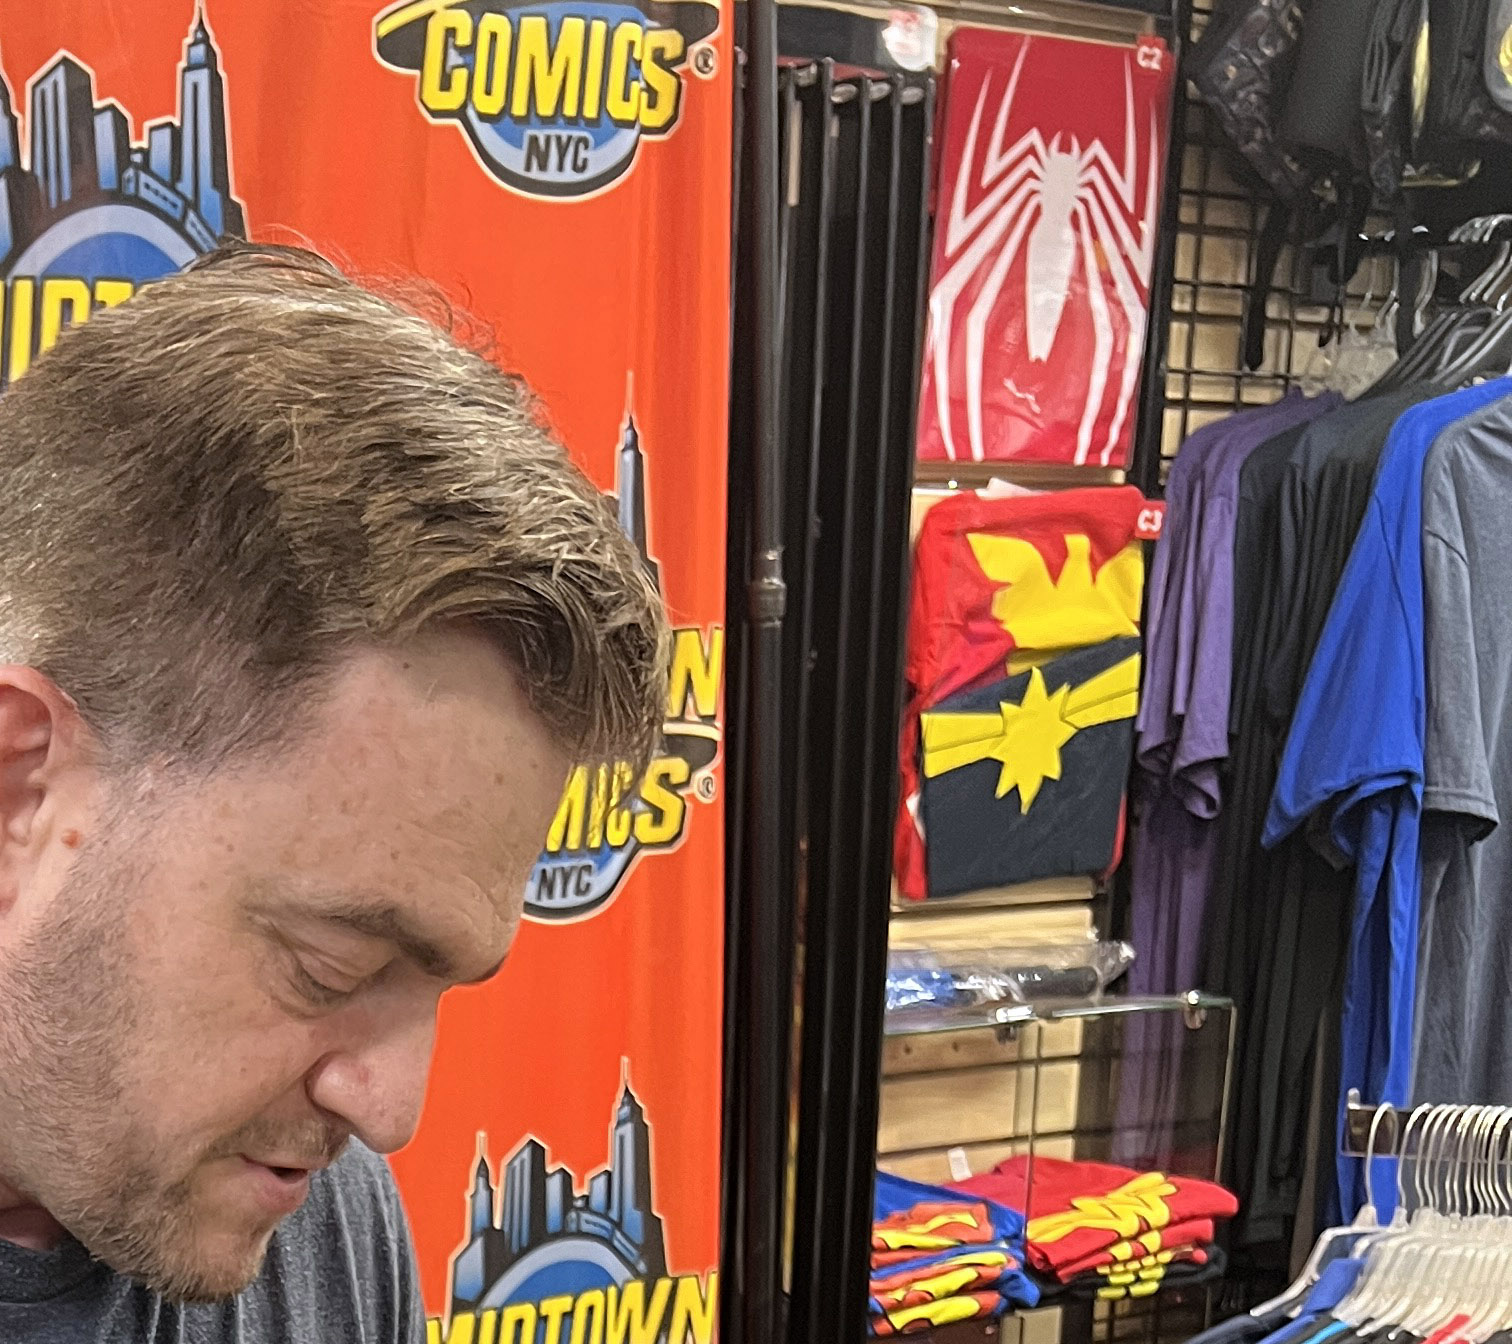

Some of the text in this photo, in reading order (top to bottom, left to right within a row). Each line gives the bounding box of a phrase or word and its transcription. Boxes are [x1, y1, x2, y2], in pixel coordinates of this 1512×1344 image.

[420, 9, 685, 128] COMICS
[1137, 45, 1163, 70] C2
[524, 133, 589, 174] NYC
[1138, 508, 1163, 532] C3
[538, 864, 593, 900] NYC
